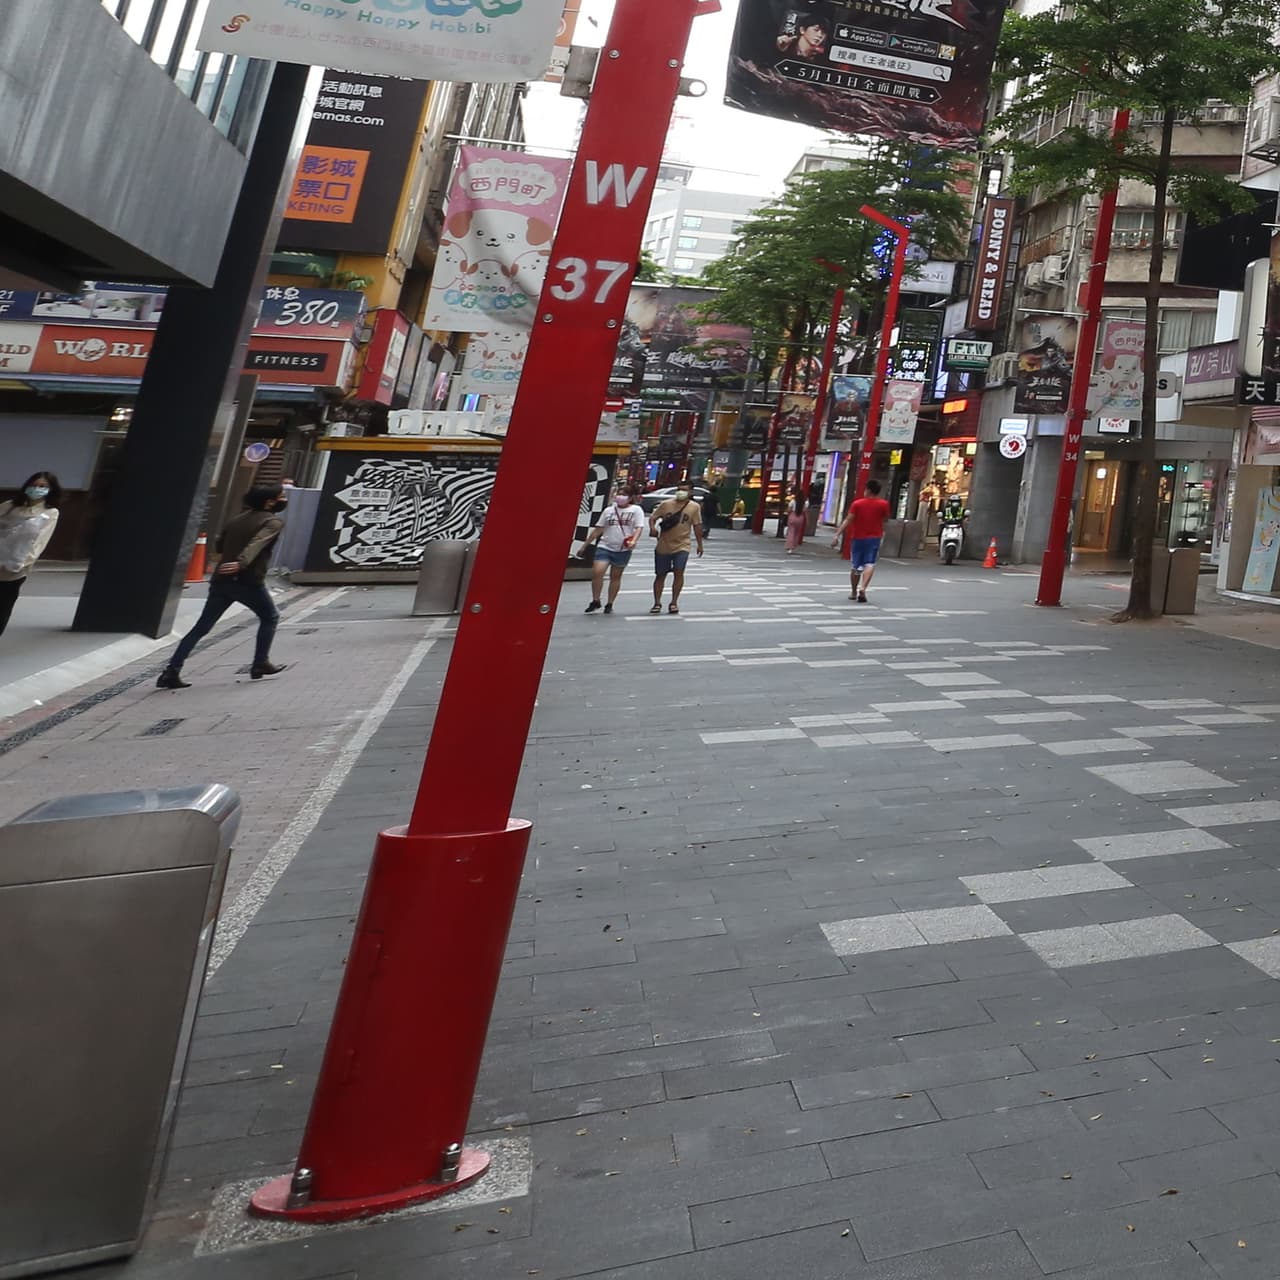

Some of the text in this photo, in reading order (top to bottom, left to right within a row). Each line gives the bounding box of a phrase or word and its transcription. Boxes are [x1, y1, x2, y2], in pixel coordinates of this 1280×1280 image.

[357, 9, 420, 30] Happy
[430, 20, 491, 34] Habibi
[320, 80, 384, 97] 活動訊息
[314, 96, 366, 111] 城官網
[302, 155, 358, 178] 影城
[470, 177, 547, 199] 西門町
[585, 160, 648, 208] W
[978, 207, 1008, 320] BONNY & READ
[551, 256, 629, 304] 37
[274, 300, 339, 327] 380
[254, 354, 320, 368] FITNESS
[1069, 434, 1080, 444] W
[1066, 453, 1078, 461] 34
